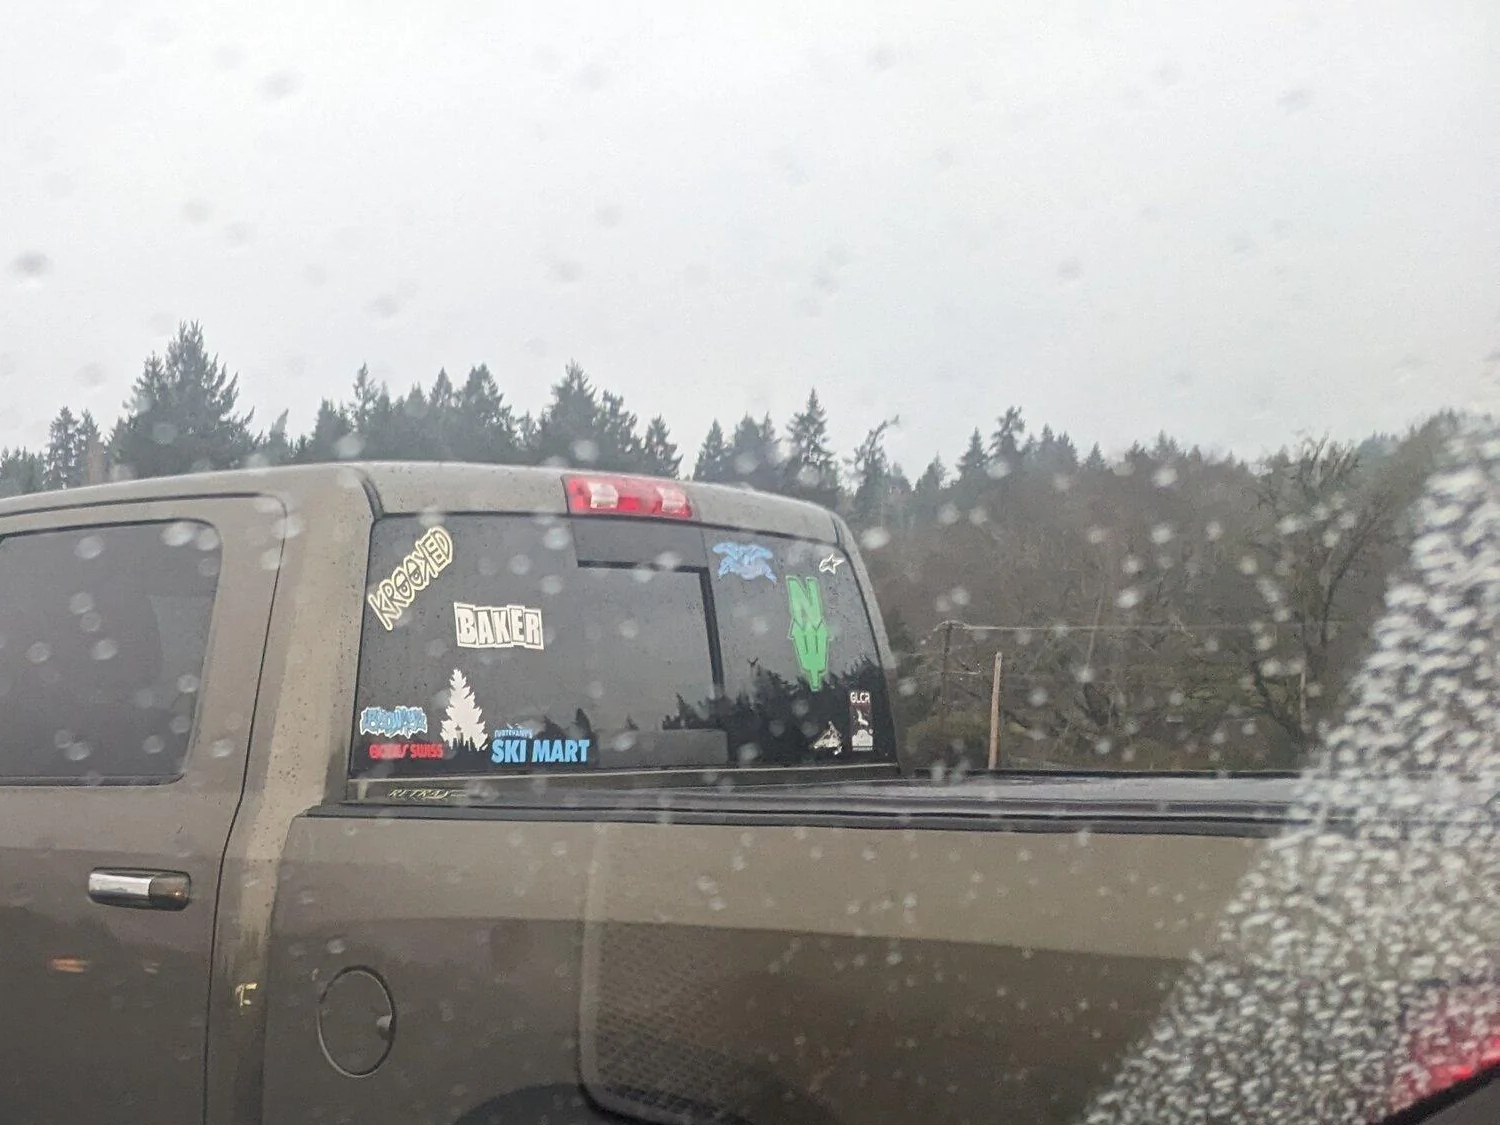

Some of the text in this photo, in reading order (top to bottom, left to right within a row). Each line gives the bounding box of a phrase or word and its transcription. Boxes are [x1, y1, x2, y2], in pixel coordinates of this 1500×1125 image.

[368, 526, 453, 630] KROOKED
[454, 603, 544, 649] BAKER
[491, 739, 590, 763] SKI MART
